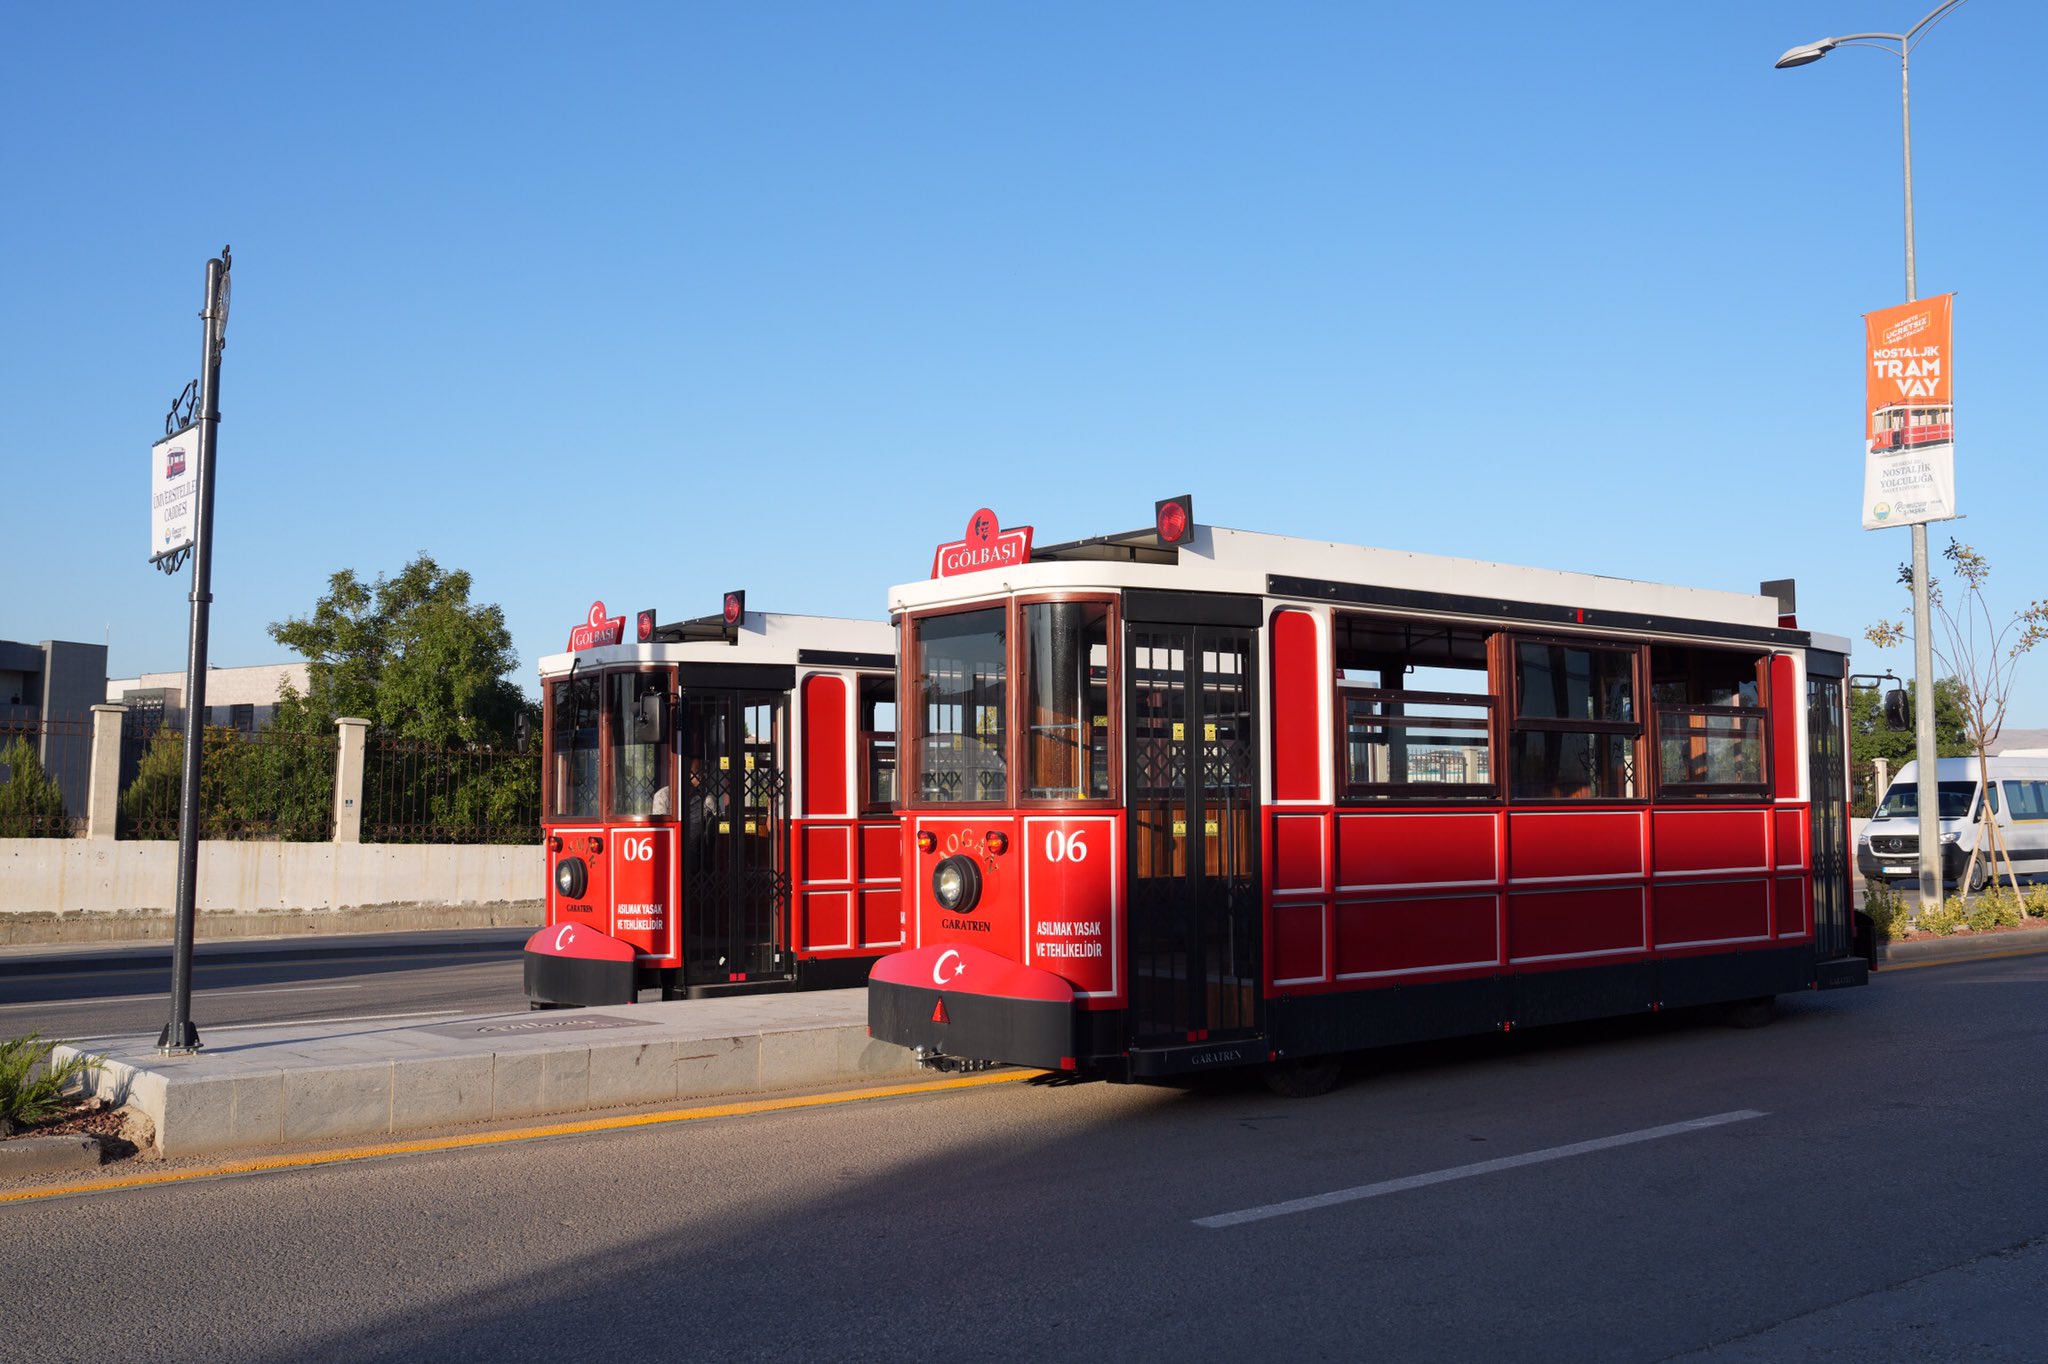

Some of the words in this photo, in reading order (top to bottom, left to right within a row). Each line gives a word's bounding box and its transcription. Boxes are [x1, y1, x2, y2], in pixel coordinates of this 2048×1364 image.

[1873, 358, 1941, 379] TRAM
[1895, 377, 1941, 397] VAY
[1882, 463, 1932, 478] NOSTALJİK
[1880, 473, 1934, 488] YOLCULUĞA
[947, 542, 1016, 569] GÖLBAŞI
[575, 627, 615, 646] GÖLBAŞI
[623, 837, 654, 861] 06
[1045, 829, 1088, 863] 06
[566, 904, 593, 912] GARATREN
[617, 904, 641, 914] ASILMAK
[642, 904, 663, 914] YASAK
[617, 919, 624, 930] VE
[624, 916, 664, 930] TEHLİKELİDİR
[941, 918, 991, 932] GARATREN
[1036, 921, 1073, 936] ASILMAK
[1074, 921, 1102, 936] YASAK
[1036, 942, 1046, 957] VE
[1047, 940, 1103, 957] TEHLİKELİDİR
[1191, 1049, 1242, 1065] GARATREN
